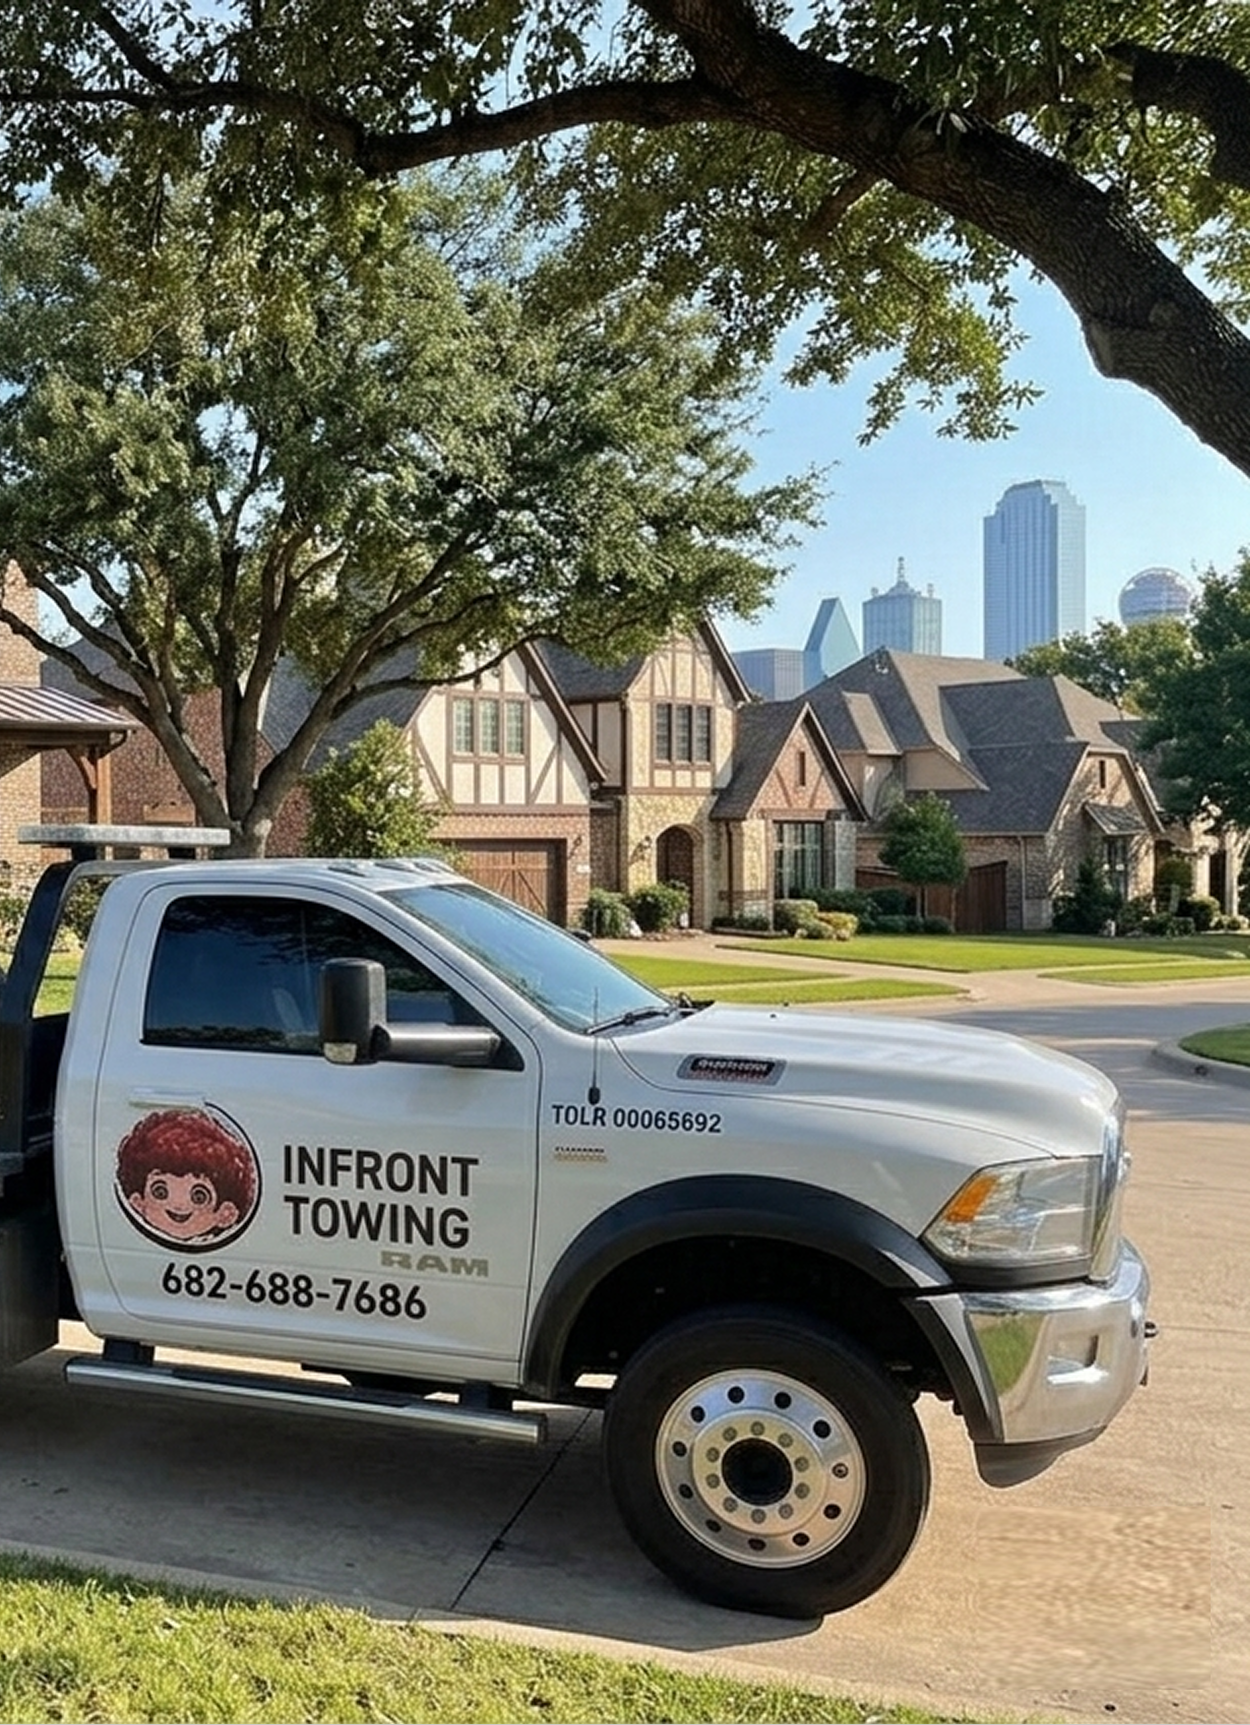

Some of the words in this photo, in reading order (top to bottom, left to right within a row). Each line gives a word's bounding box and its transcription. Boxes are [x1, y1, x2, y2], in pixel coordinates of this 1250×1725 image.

[552, 1104, 606, 1127] TOLR
[613, 1107, 722, 1133] 00065692
[283, 1144, 479, 1197] INFRONT
[283, 1195, 470, 1248] TOWING
[161, 1261, 427, 1319] 682-688-7686
[380, 1250, 489, 1277] RAM
